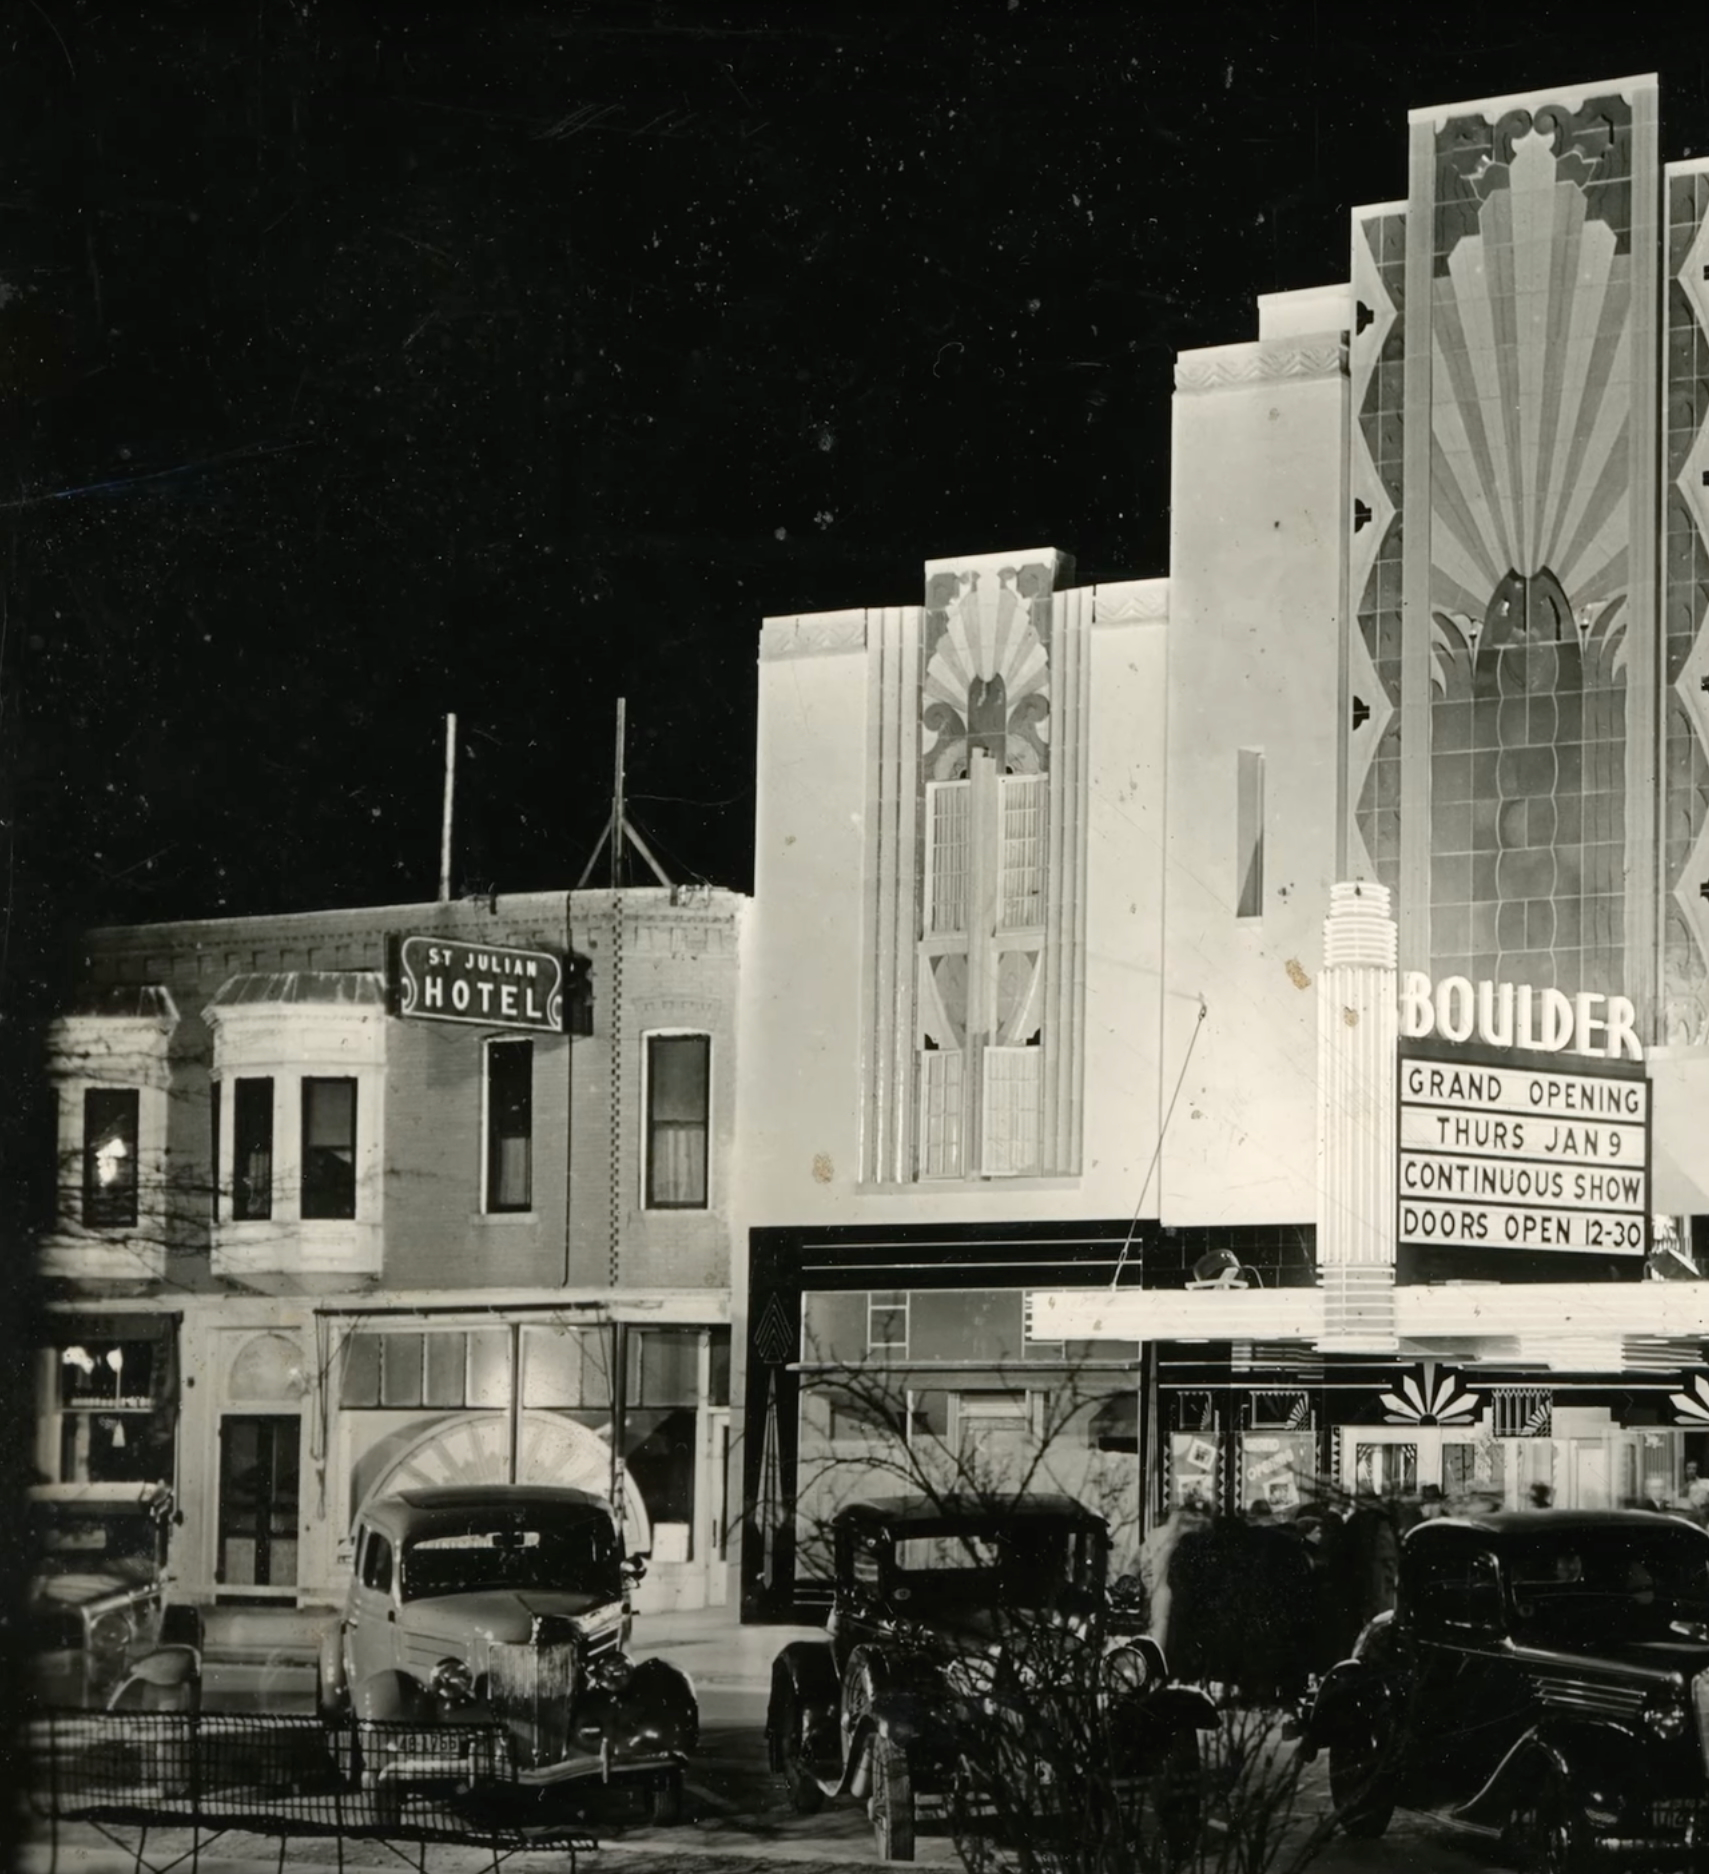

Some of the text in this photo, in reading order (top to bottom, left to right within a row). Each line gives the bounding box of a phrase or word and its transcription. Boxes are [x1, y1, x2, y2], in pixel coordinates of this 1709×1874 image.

[428, 948, 537, 977] ST JULIAN
[425, 975, 542, 1018] HOTEL
[1400, 971, 1643, 1060] BOULDER
[1408, 1067, 1640, 1114] GRAND OPENING
[1436, 1116, 1622, 1157] THURS JAN 9
[1404, 1160, 1641, 1204] CONTINUOUS SHOW
[1404, 1208, 1642, 1248] DOORS OPEN 12-30
